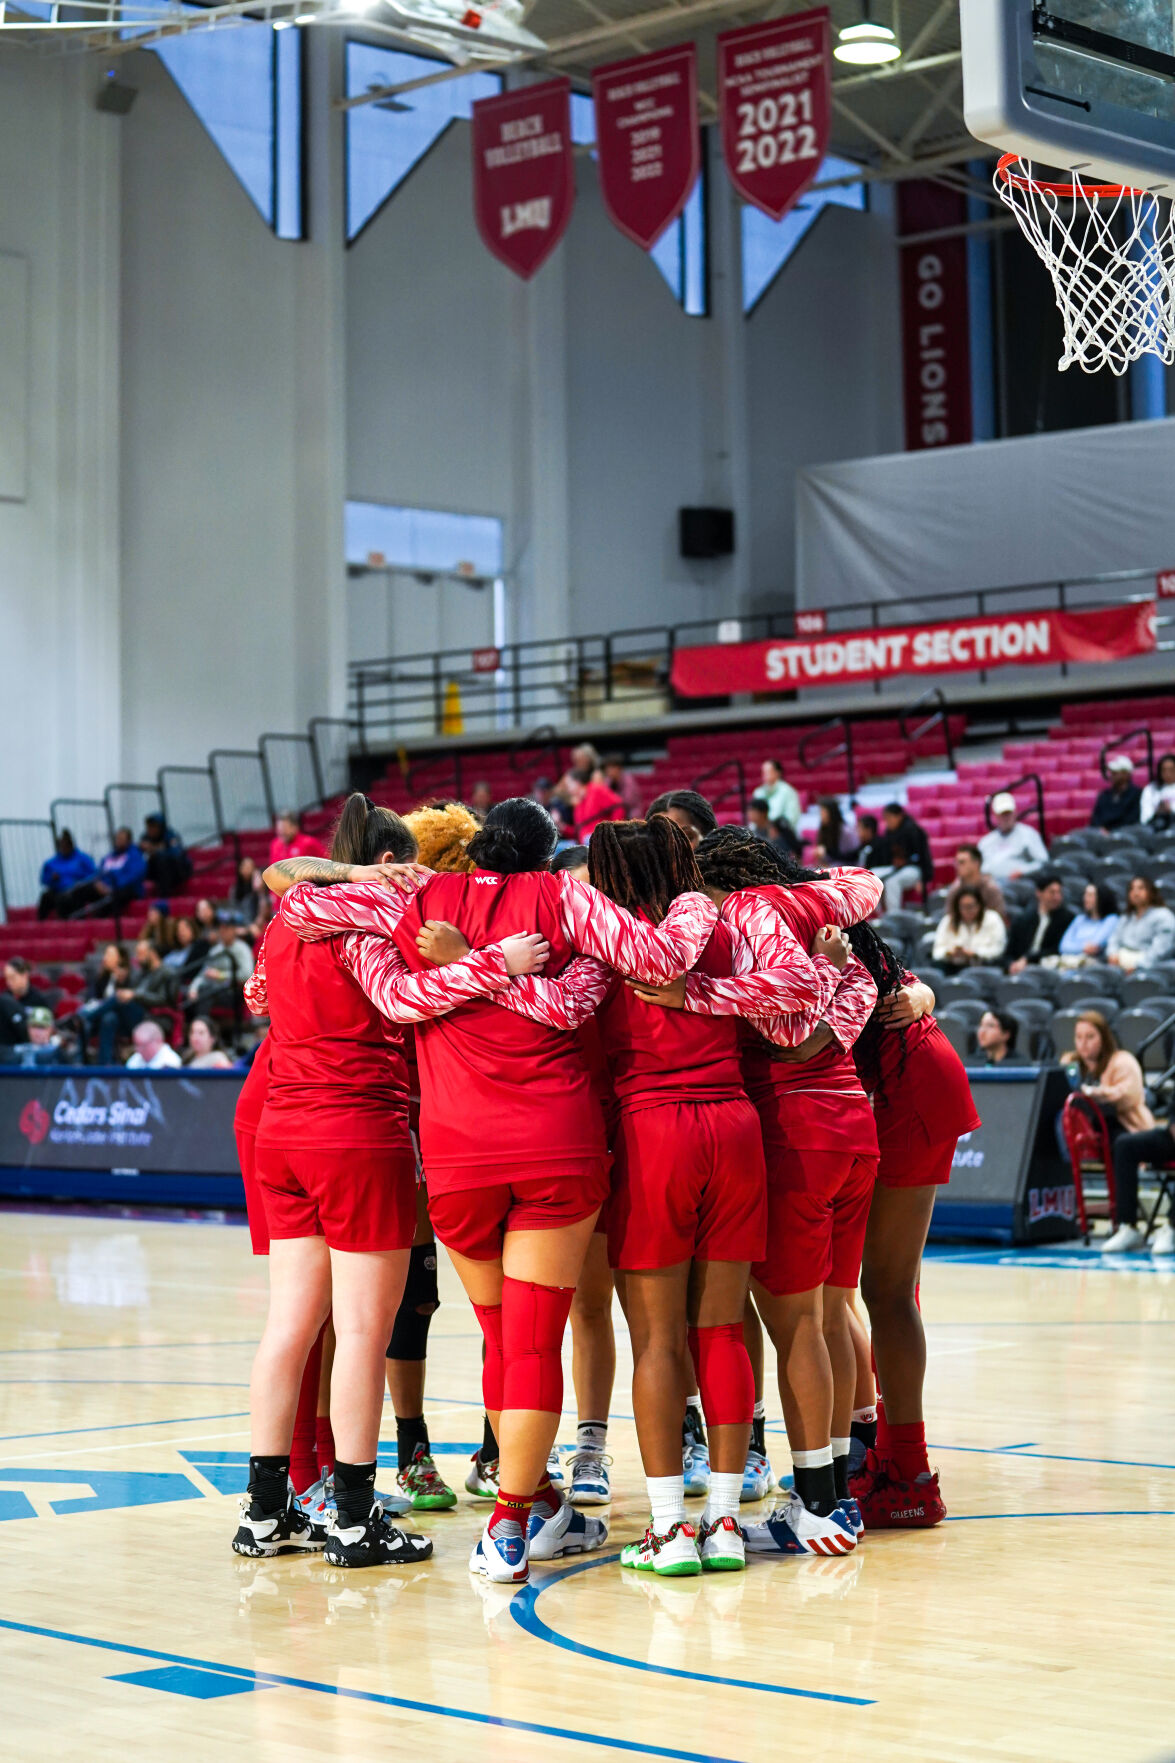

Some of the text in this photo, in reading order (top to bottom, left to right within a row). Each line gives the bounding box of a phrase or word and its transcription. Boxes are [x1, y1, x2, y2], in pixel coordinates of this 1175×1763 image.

[737, 88, 812, 136] 2021
[484, 131, 563, 169] VOLLEYBALL
[737, 125, 818, 173] 2022
[501, 196, 552, 238] LMU
[918, 254, 948, 445] GO LIONS
[766, 619, 1049, 681] STUDENT SECTION
[475, 876, 498, 885] WCC
[1028, 1186, 1077, 1224] LMU
[890, 1506, 925, 1519] QUEENS
